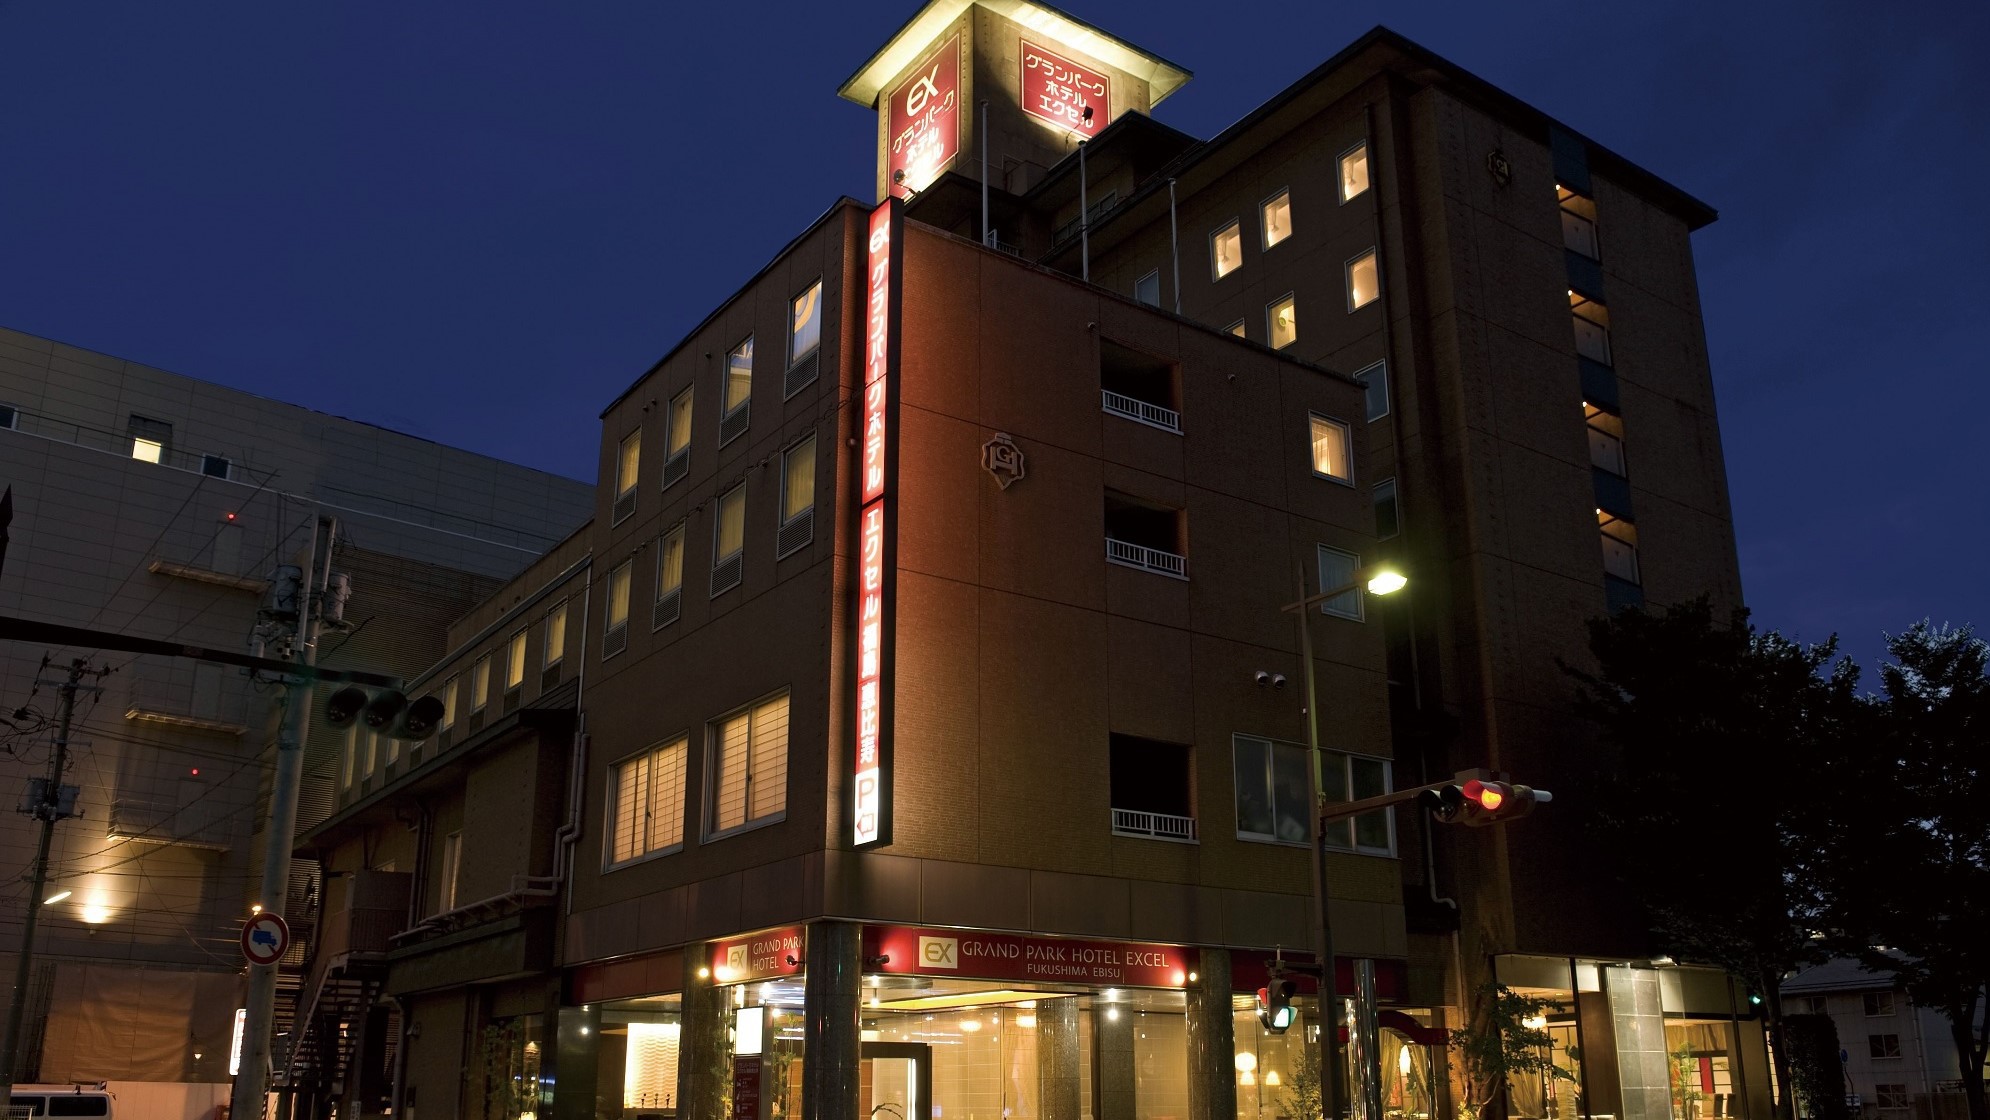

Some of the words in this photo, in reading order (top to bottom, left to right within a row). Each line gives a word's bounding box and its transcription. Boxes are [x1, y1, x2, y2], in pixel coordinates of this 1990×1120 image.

[906, 63, 939, 117] EX
[1026, 53, 1105, 97] グランパーク
[1045, 80, 1087, 108] ホテル
[892, 89, 954, 154] グランパーク
[858, 778, 875, 809] P
[730, 948, 745, 969] EX
[752, 938, 781, 955] GRAND
[783, 936, 804, 950] PARK
[752, 956, 779, 972] HOTEL
[924, 942, 952, 964] EX
[962, 941, 1020, 959] GRAND
[1026, 945, 1066, 961] PARK
[1072, 948, 1120, 965] HOTEL
[1126, 951, 1170, 968] EXCEL
[1027, 963, 1088, 977] FUKUSHIMA
[1093, 967, 1120, 978] EBISU
